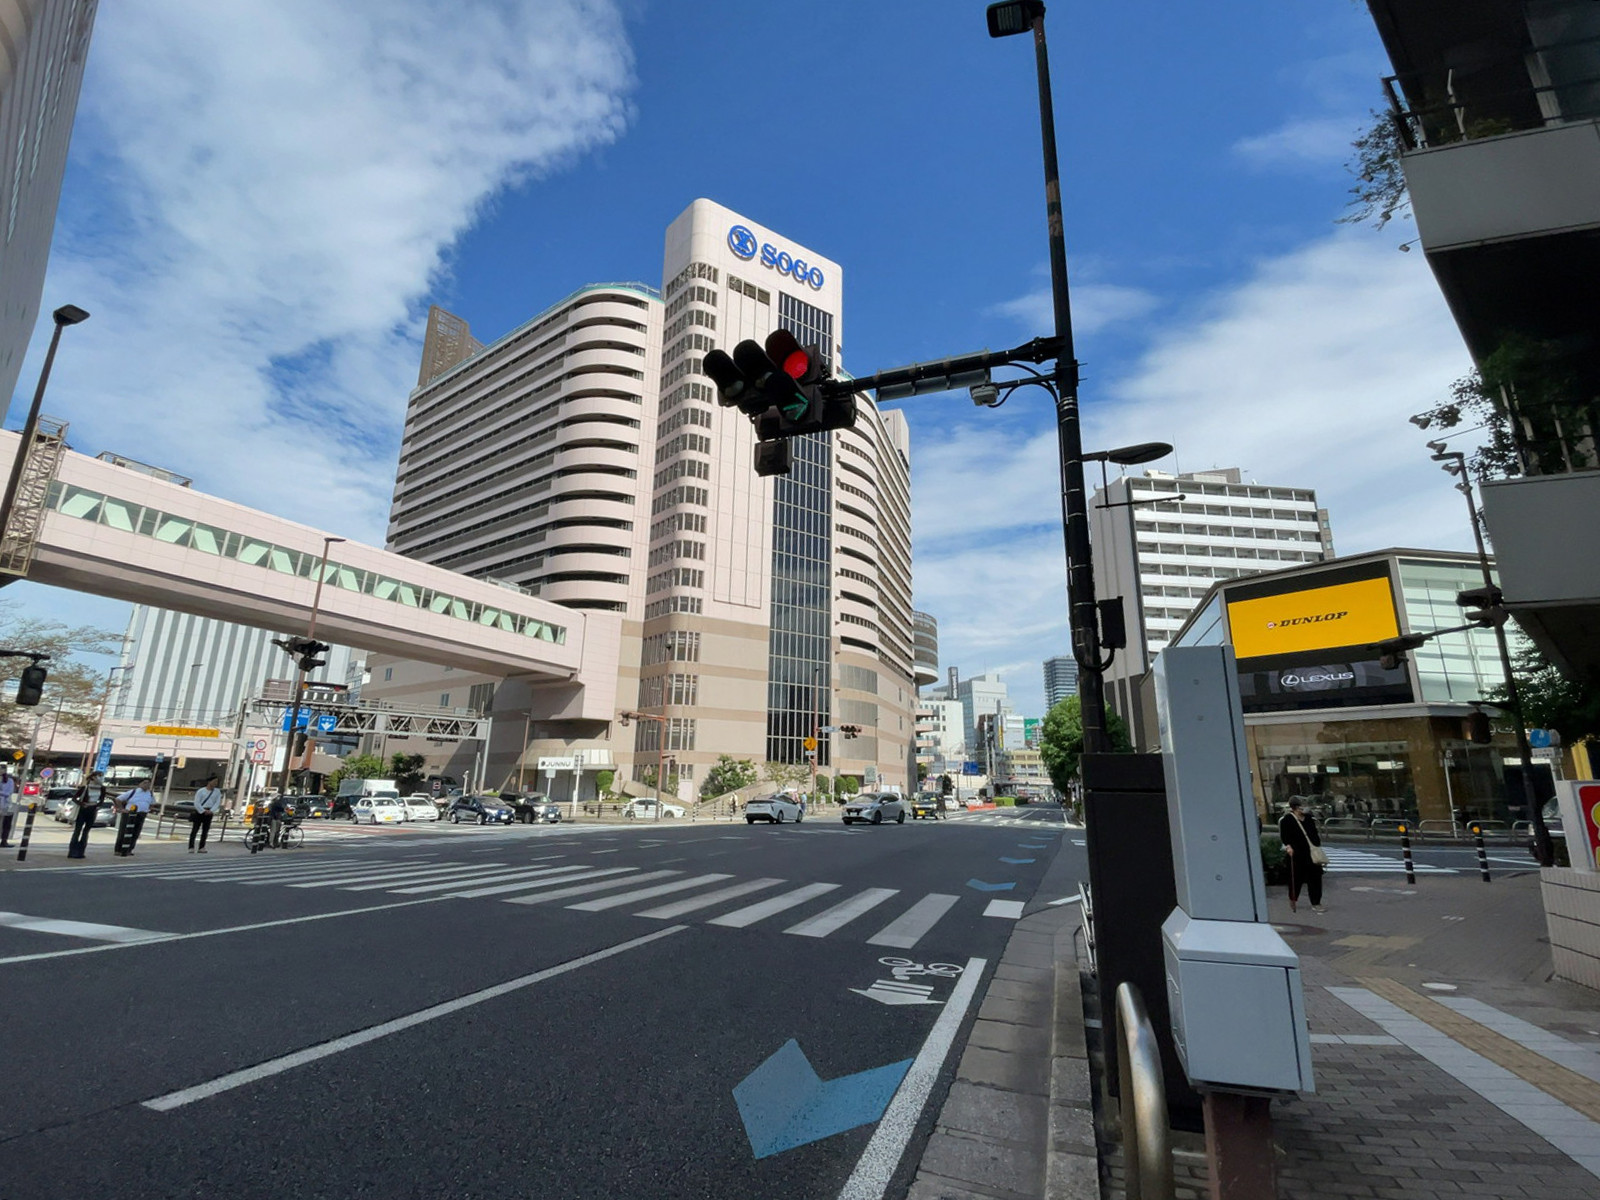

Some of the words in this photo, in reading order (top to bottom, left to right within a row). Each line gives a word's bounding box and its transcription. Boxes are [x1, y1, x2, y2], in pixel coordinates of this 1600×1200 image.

[761, 243, 824, 288] SOGO
[1279, 611, 1348, 627] DUNLOP
[1300, 671, 1354, 683] LEXUS
